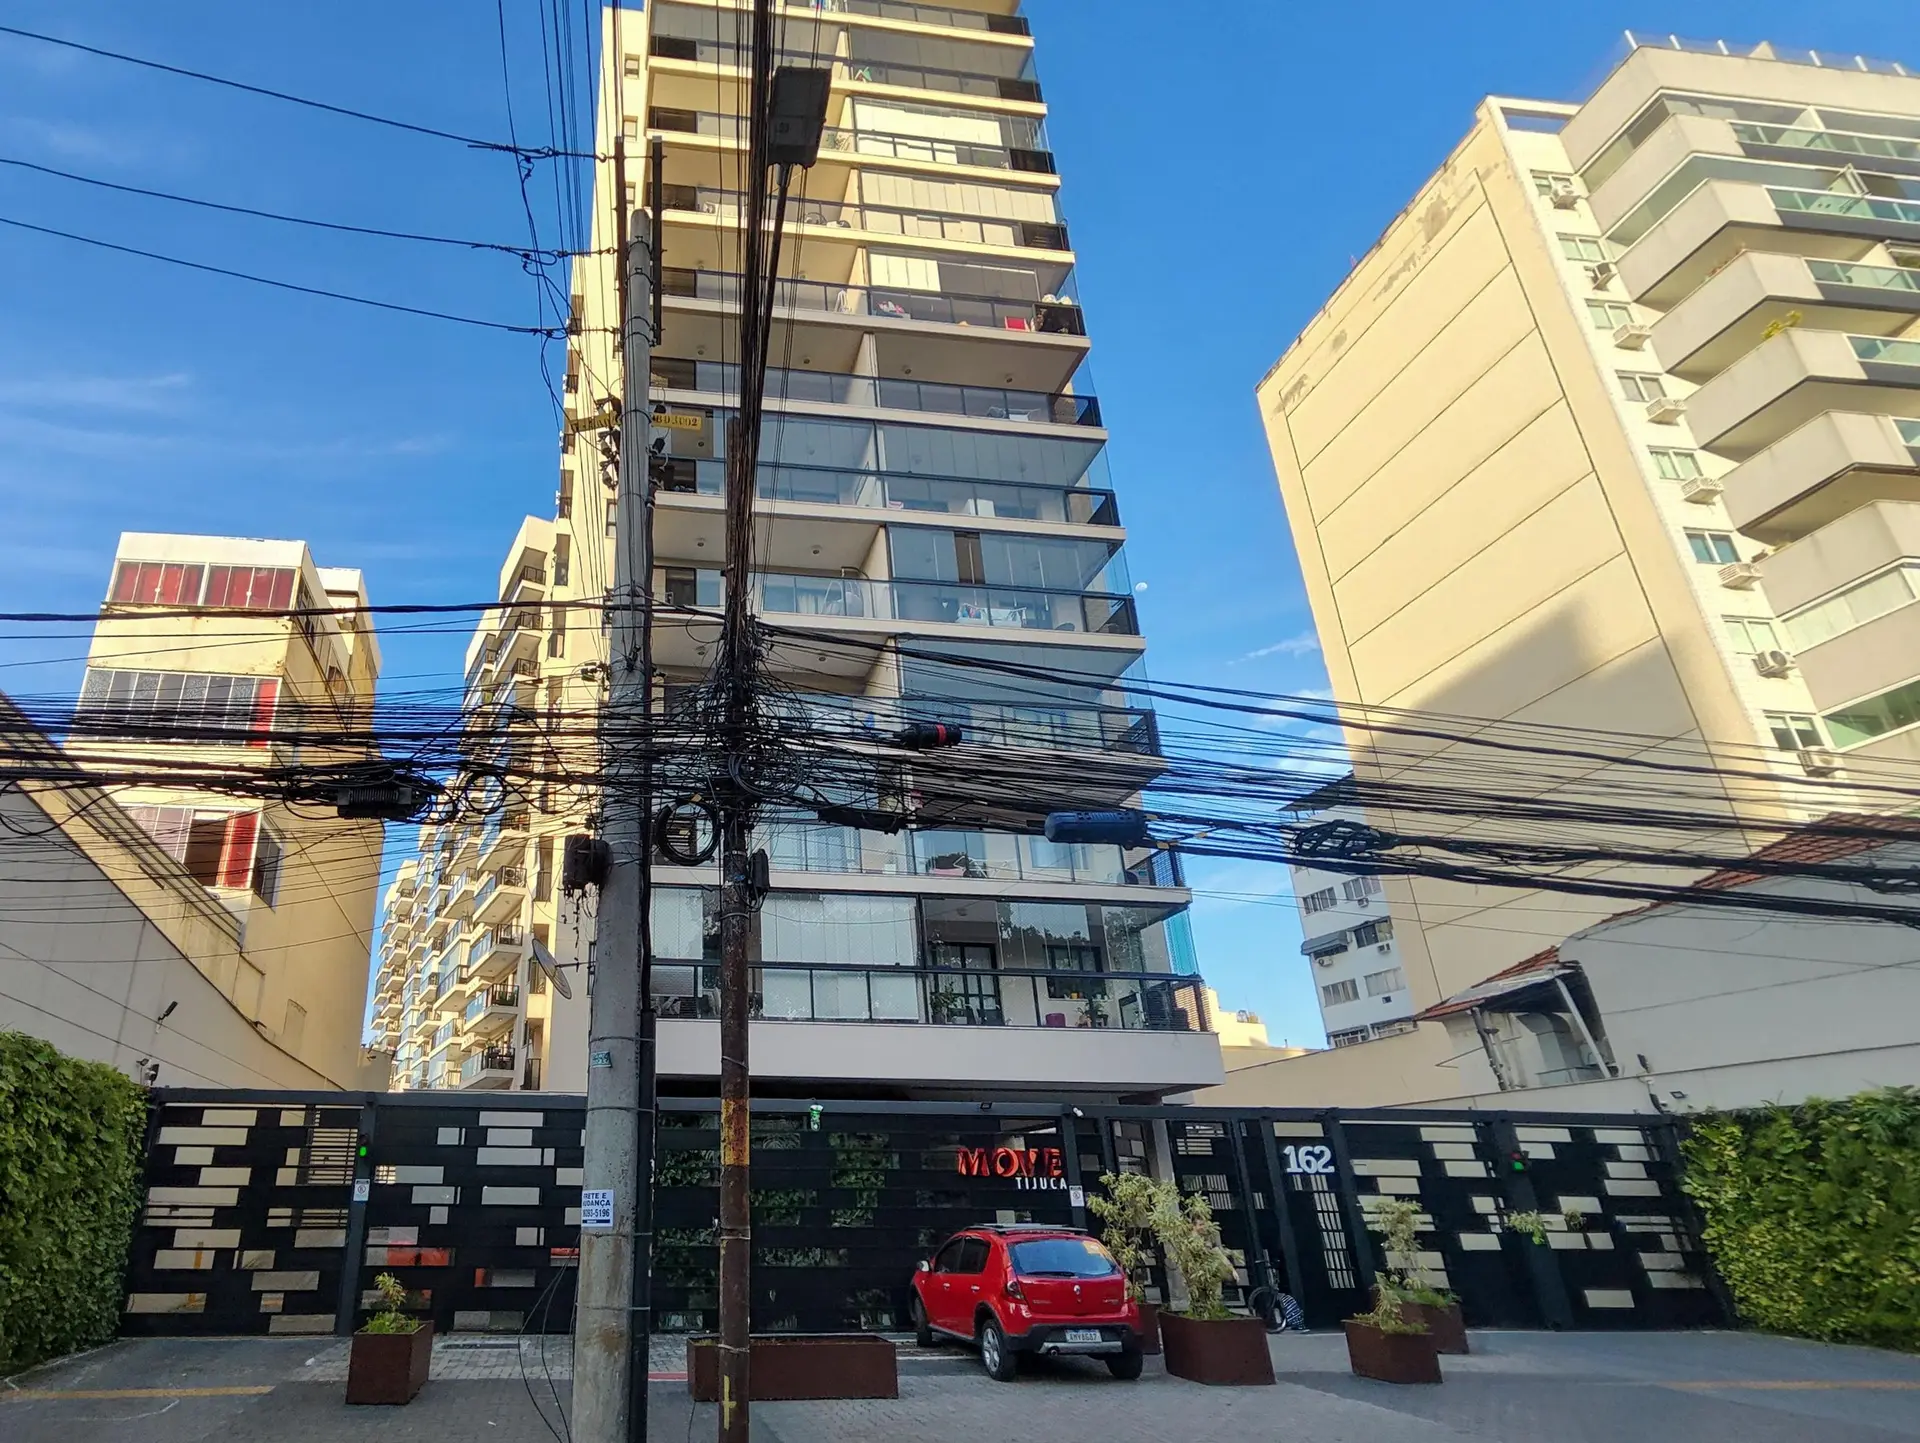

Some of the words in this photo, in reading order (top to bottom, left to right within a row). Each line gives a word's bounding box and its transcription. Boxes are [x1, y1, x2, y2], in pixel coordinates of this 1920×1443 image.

[957, 1147, 1063, 1177] MOVE
[1283, 1144, 1335, 1173] 162
[1015, 1177, 1067, 1190] TIJUCA
